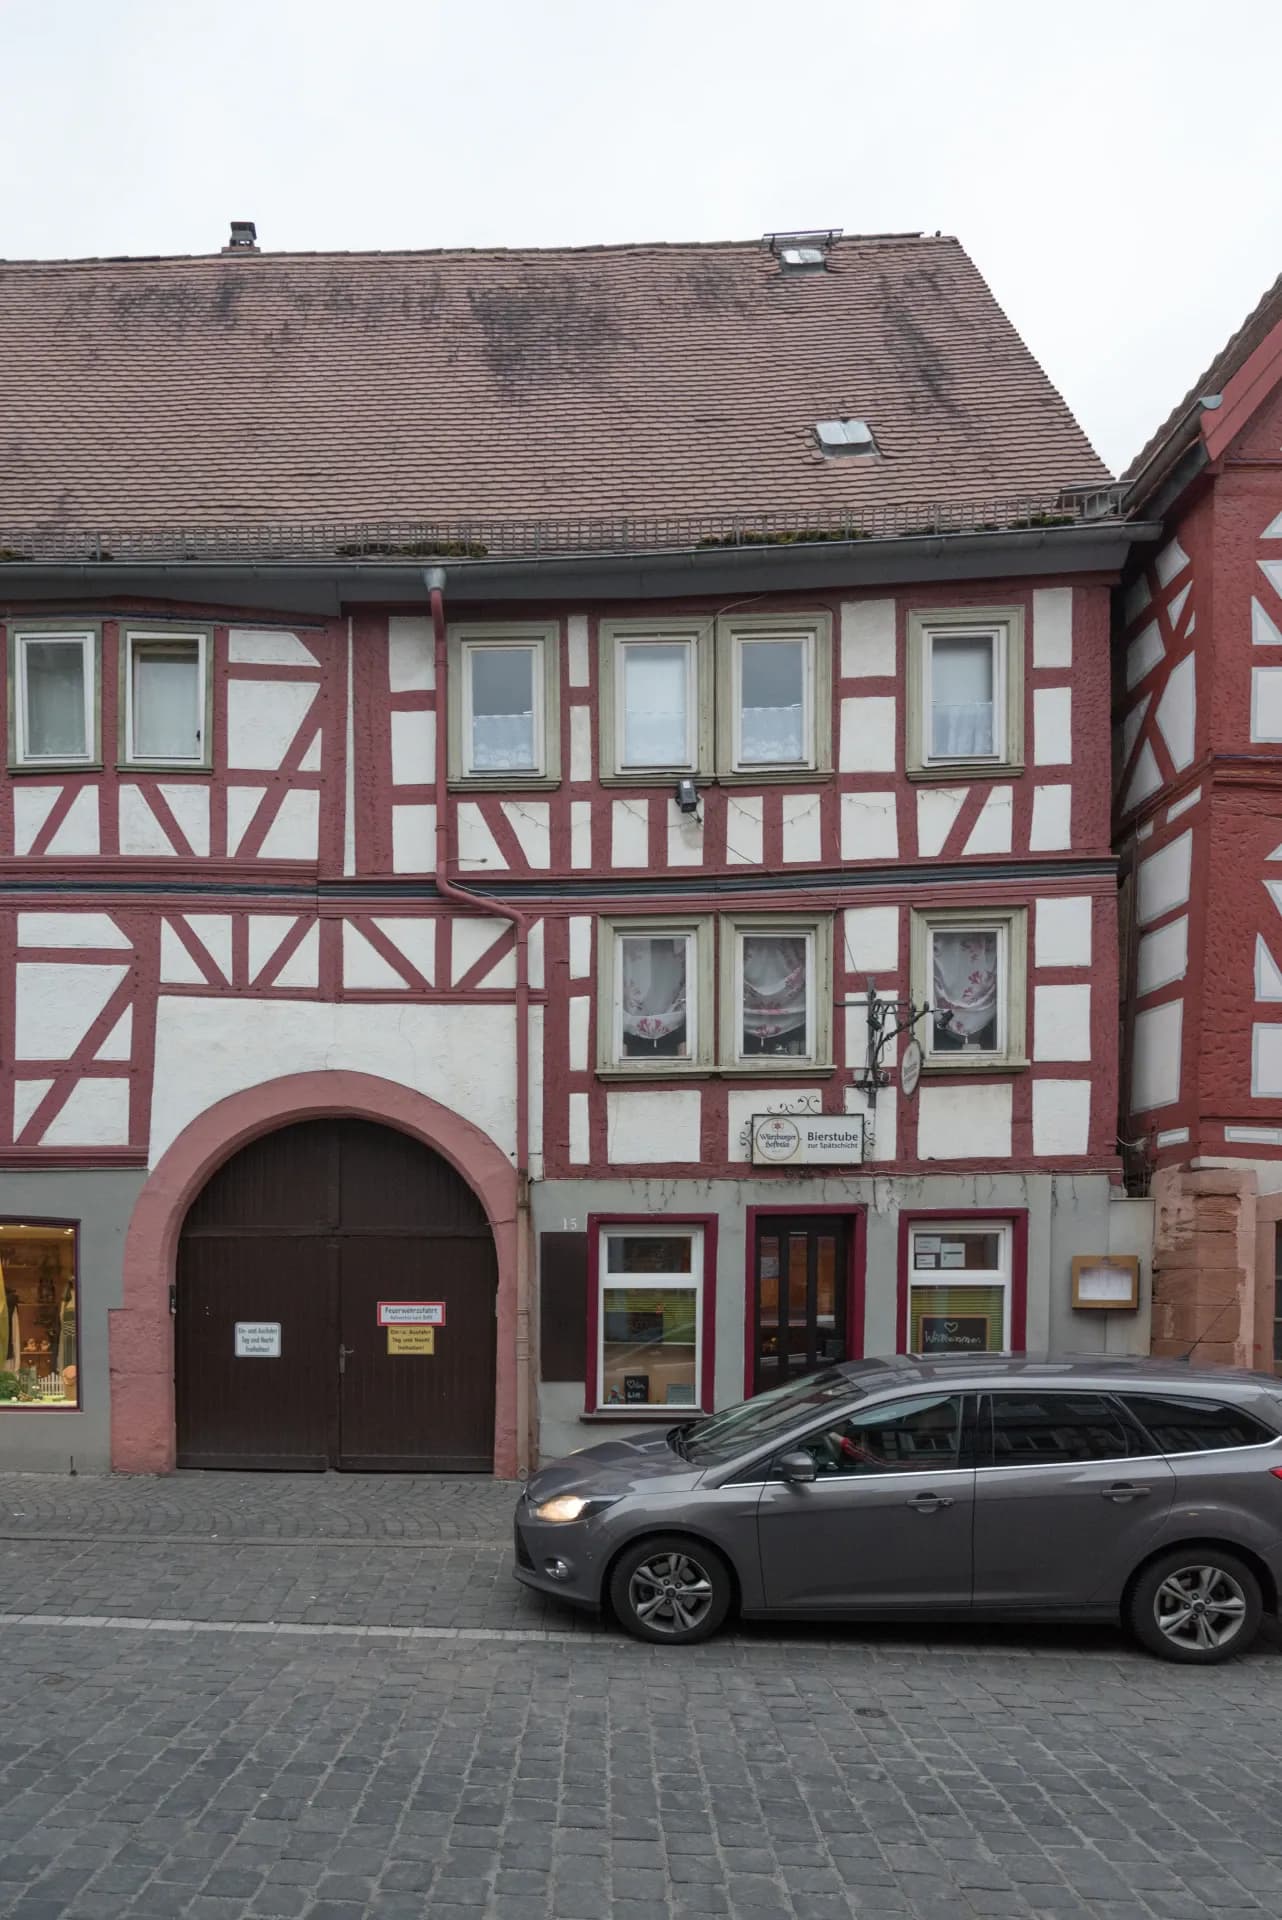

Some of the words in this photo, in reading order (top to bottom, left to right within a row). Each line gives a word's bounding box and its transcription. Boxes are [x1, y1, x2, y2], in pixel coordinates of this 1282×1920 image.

[807, 1131, 859, 1141] Bierstube
[820, 1142, 858, 1150] Spätschicht
[563, 1217, 577, 1231] 15
